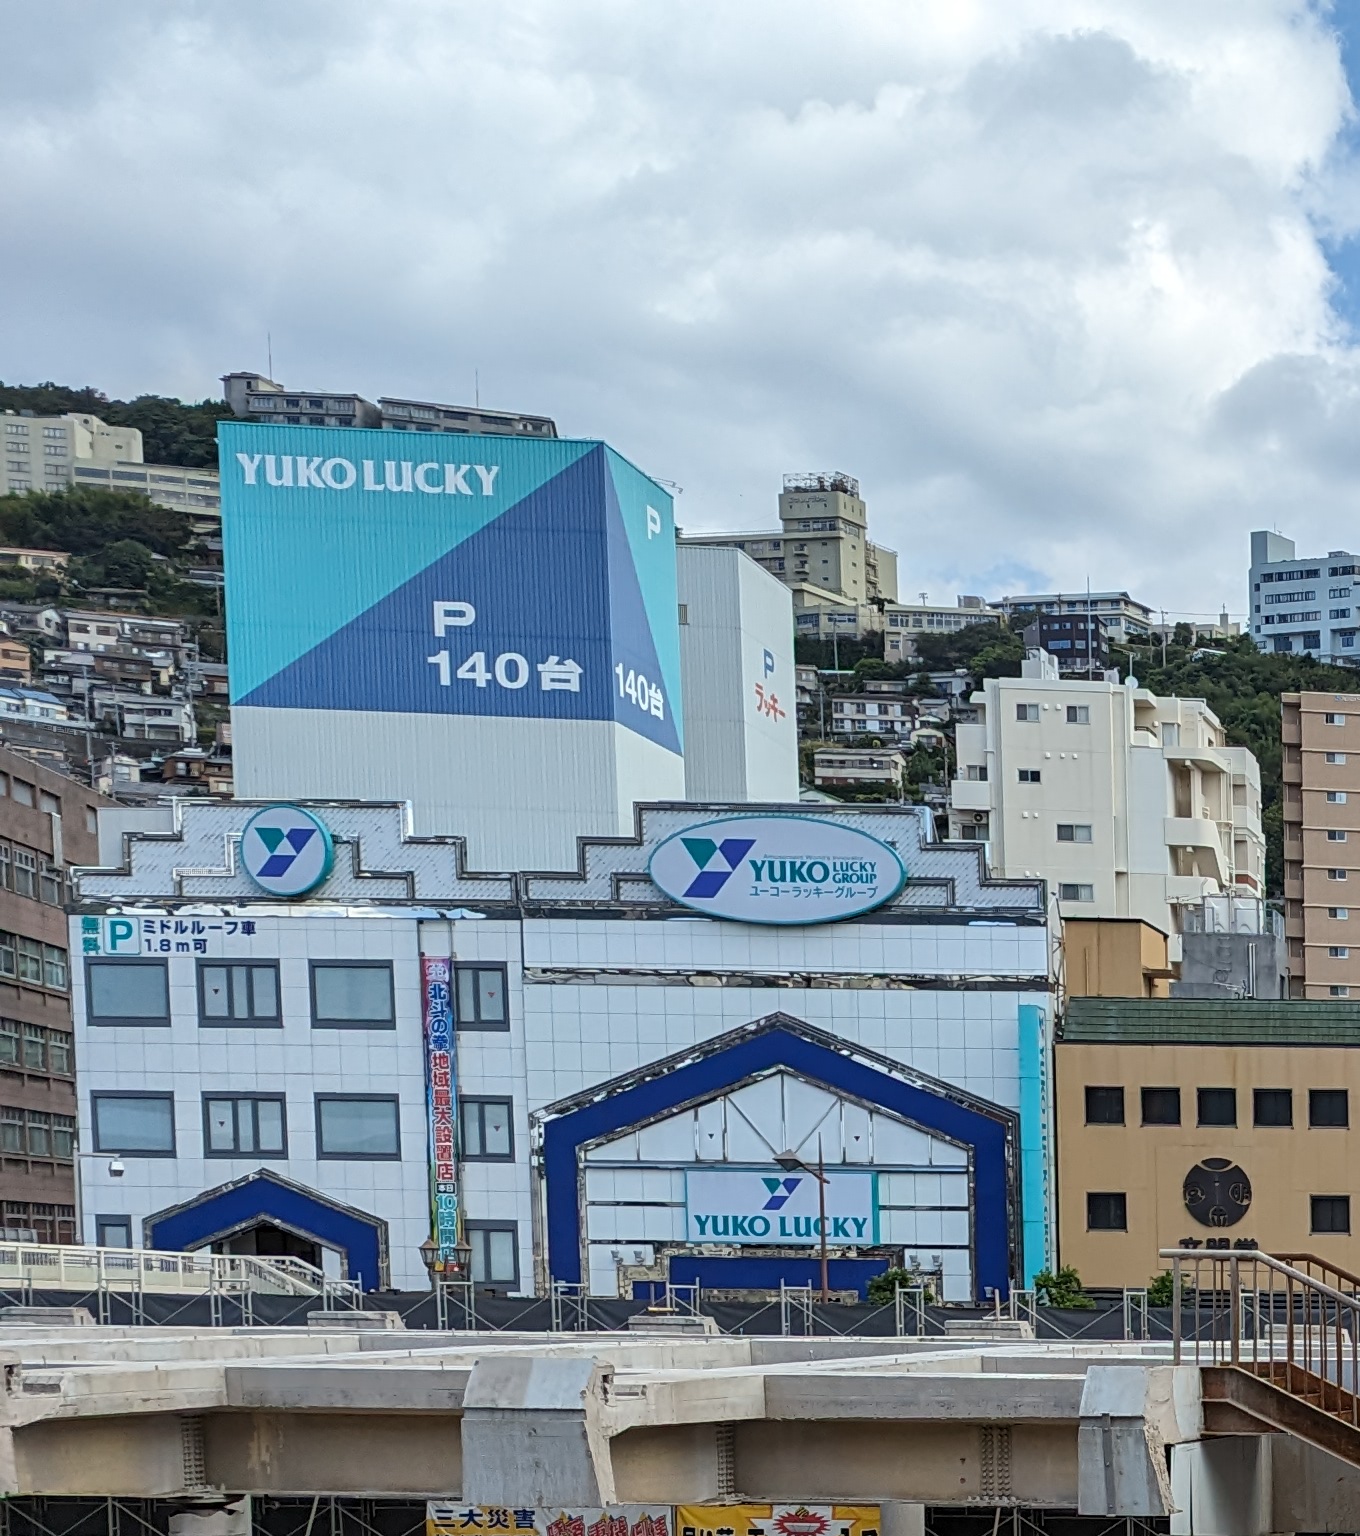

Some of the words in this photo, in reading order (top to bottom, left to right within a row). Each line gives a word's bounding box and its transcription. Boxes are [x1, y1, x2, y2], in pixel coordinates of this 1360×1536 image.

[236, 453, 357, 490] YUKO
[362, 459, 500, 496] LUCKY
[646, 505, 661, 539] P
[433, 601, 476, 637] P
[427, 650, 584, 692] 140台
[763, 648, 775, 679] P
[615, 662, 664, 720] 140台
[755, 682, 786, 722] ラッキー
[748, 860, 830, 883] YUKO
[832, 861, 877, 873] LUCKY
[832, 873, 877, 884] GROUP
[749, 886, 879, 899] ユーコーラッキーグループ
[82, 917, 100, 955] 無料
[109, 920, 133, 951] P
[143, 919, 257, 936] ミドルルーフ車
[431, 1053, 454, 1181] 地域最大設置店
[694, 1215, 771, 1236] YUKO
[779, 1216, 868, 1238] LUCKY
[434, 1508, 536, 1529] 三大災害
